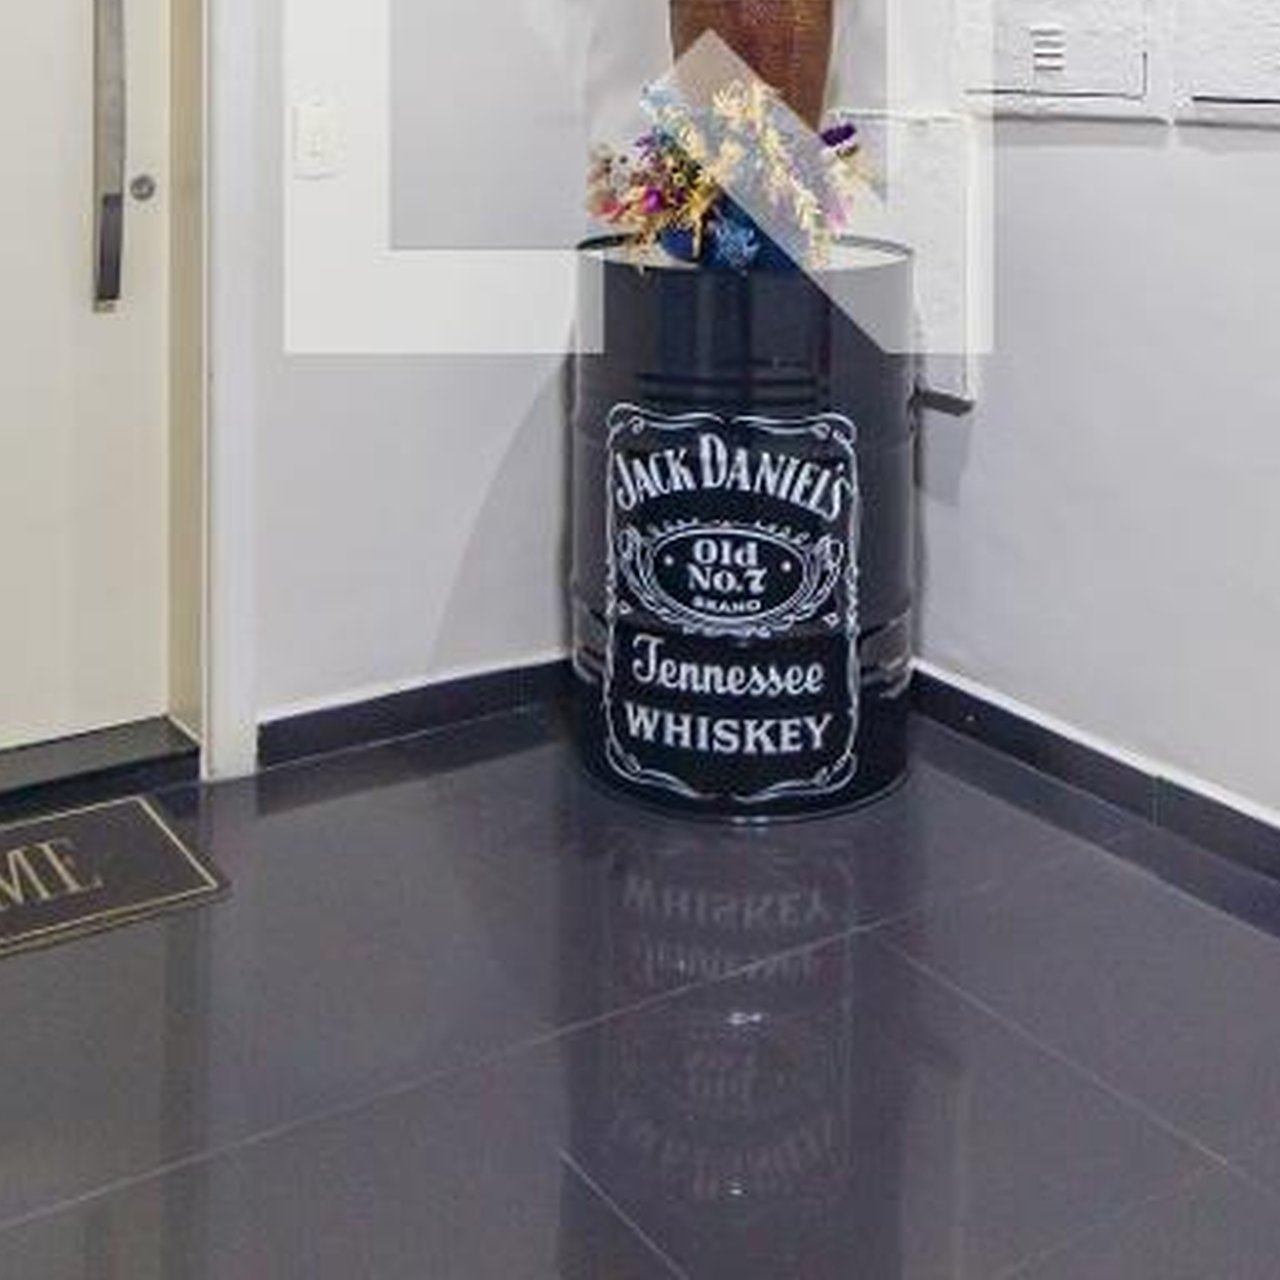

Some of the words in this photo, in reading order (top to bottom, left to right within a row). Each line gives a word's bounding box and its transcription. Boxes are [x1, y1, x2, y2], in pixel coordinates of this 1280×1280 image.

[693, 538, 758, 567] Old
[691, 595, 762, 613] BRAND
[631, 633, 826, 696] Tennessee
[623, 700, 834, 756] WHISKEY
